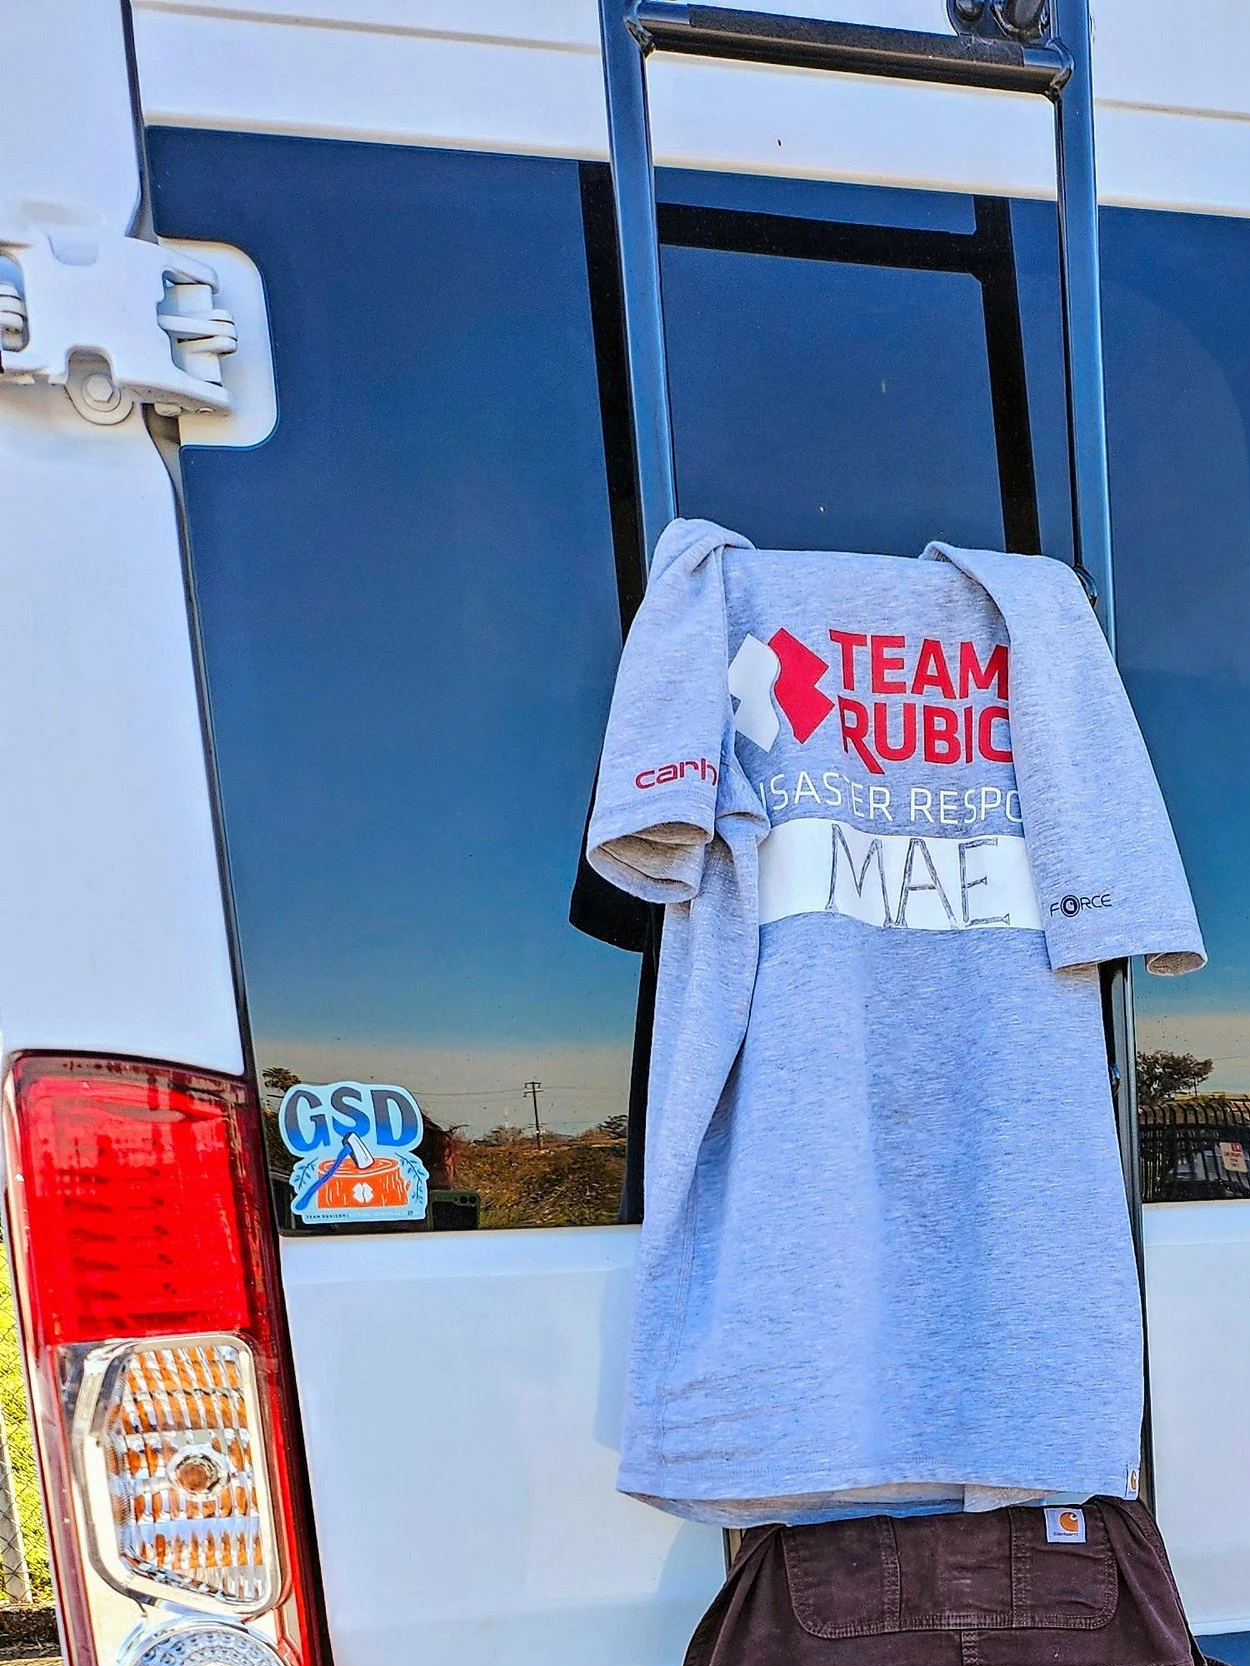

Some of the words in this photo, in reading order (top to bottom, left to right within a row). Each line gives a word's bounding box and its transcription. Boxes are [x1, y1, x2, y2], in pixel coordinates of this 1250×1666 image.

[829, 629, 1009, 701] TEAM
[635, 758, 718, 789] carh
[825, 823, 1011, 929] MAE
[1050, 894, 1113, 918] FORCE
[284, 1086, 419, 1151] GSD
